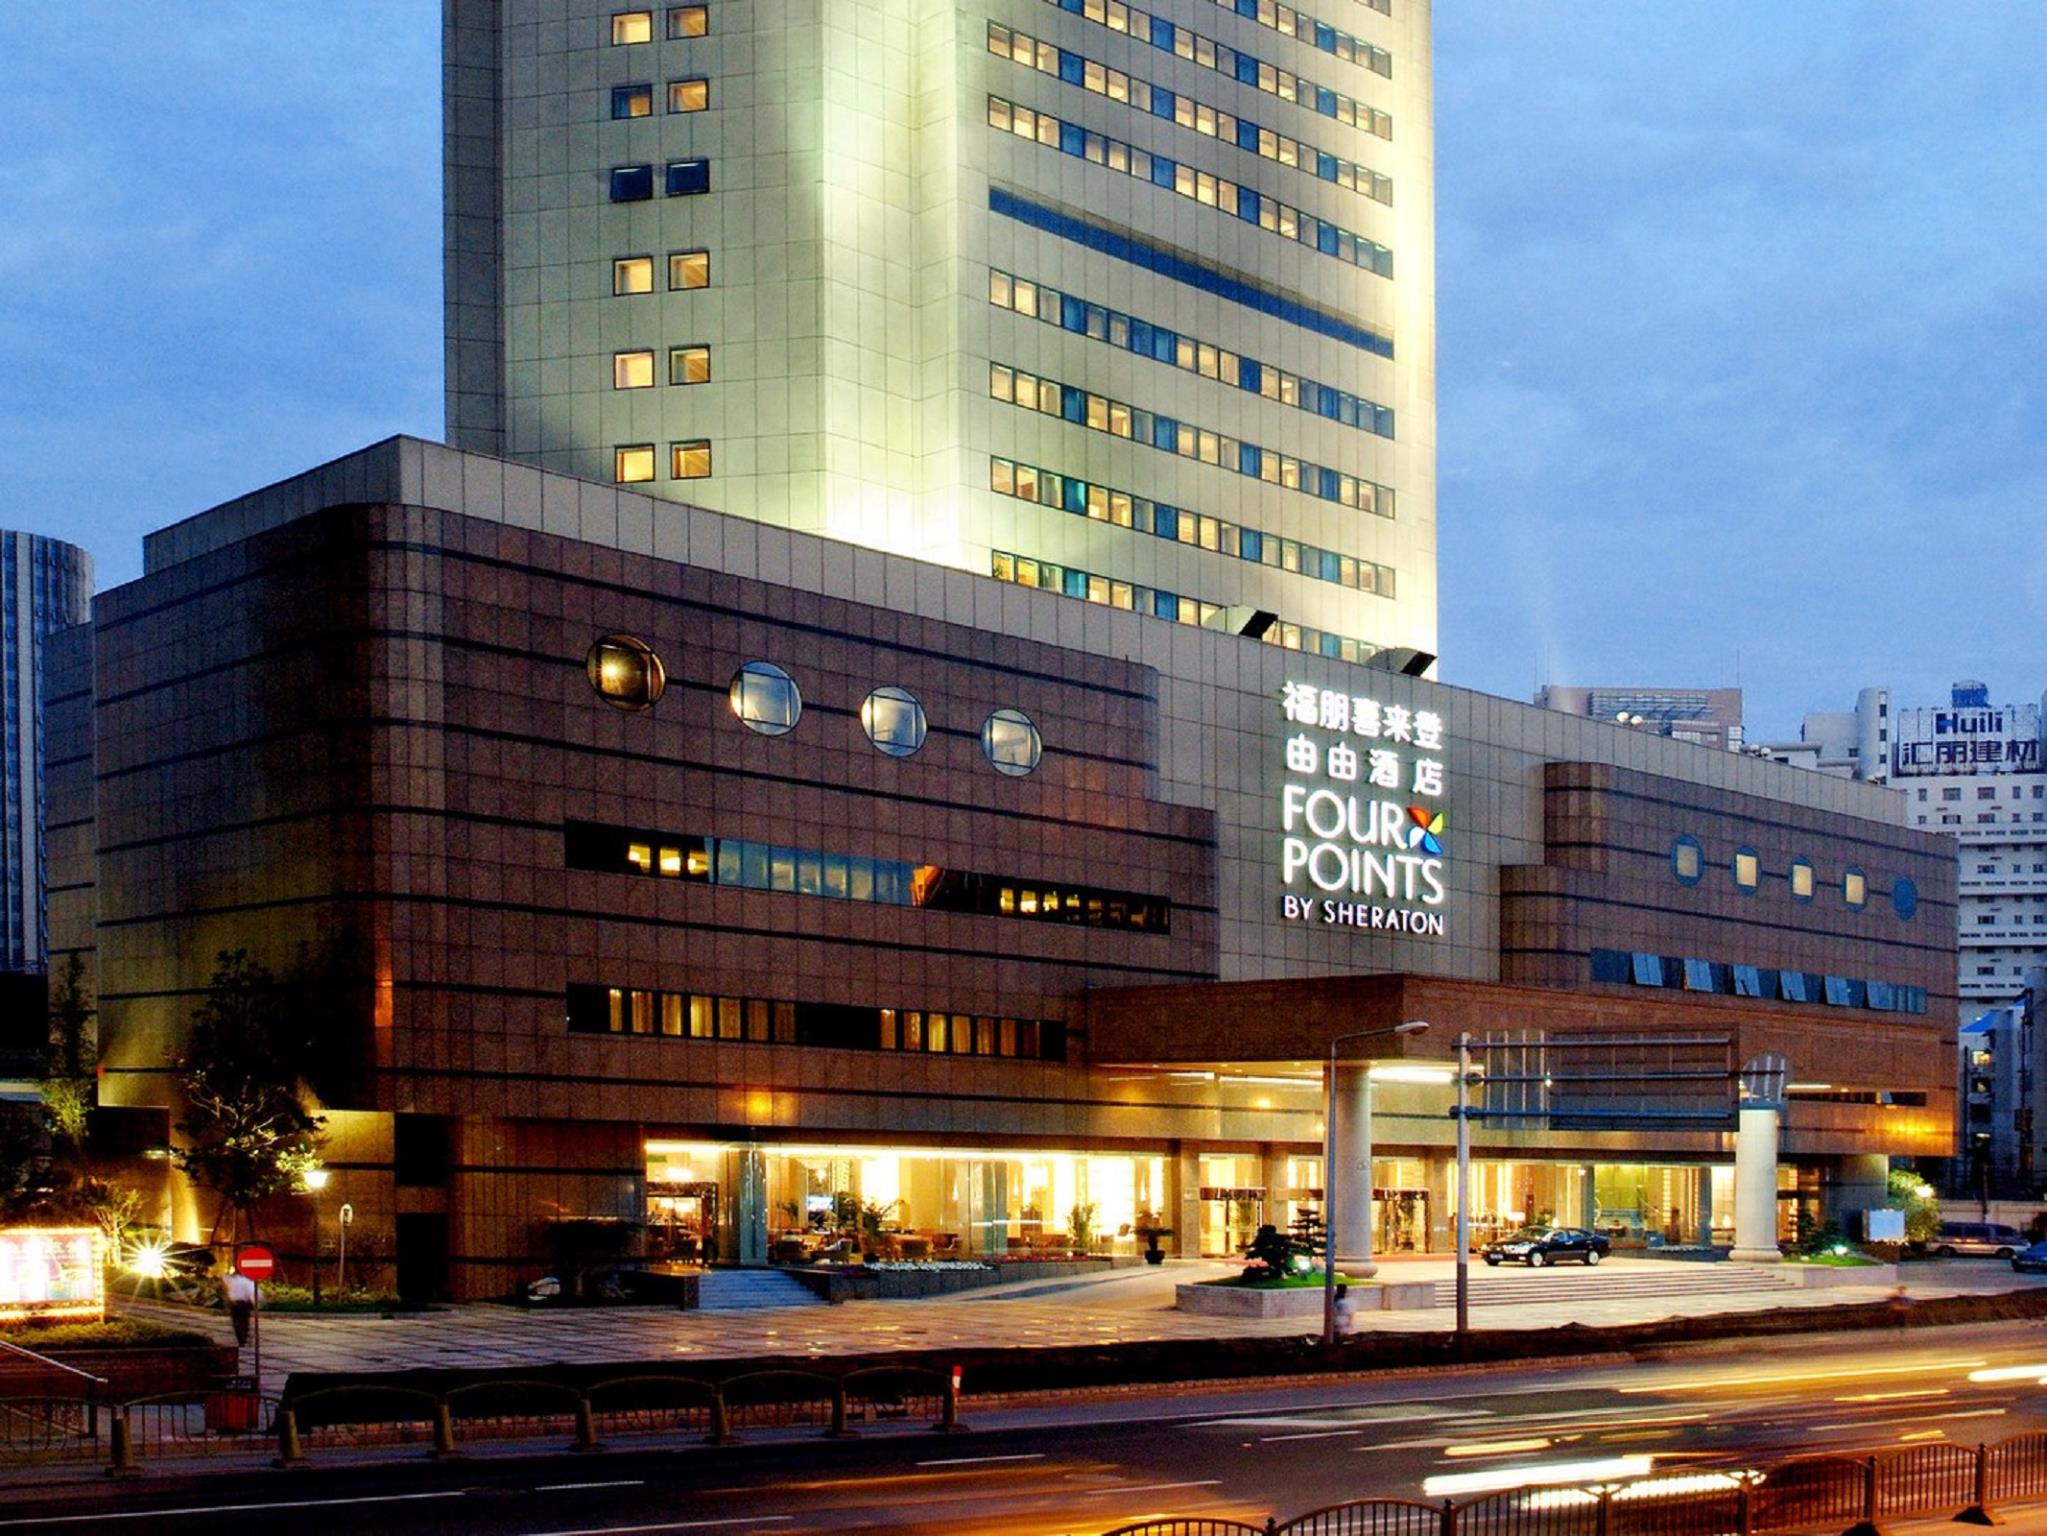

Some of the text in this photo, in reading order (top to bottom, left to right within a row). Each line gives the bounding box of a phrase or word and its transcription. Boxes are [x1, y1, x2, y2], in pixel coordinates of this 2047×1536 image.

[1284, 680, 1442, 750] 福朋喜来登
[1935, 711, 2003, 734] Huili
[1286, 733, 1443, 796] 由由酒店
[1902, 740, 2039, 766] 汇丽建材
[1283, 784, 1408, 850] FOUR
[1283, 837, 1444, 905] POINTS
[1284, 895, 1443, 936] BY SHERATON
